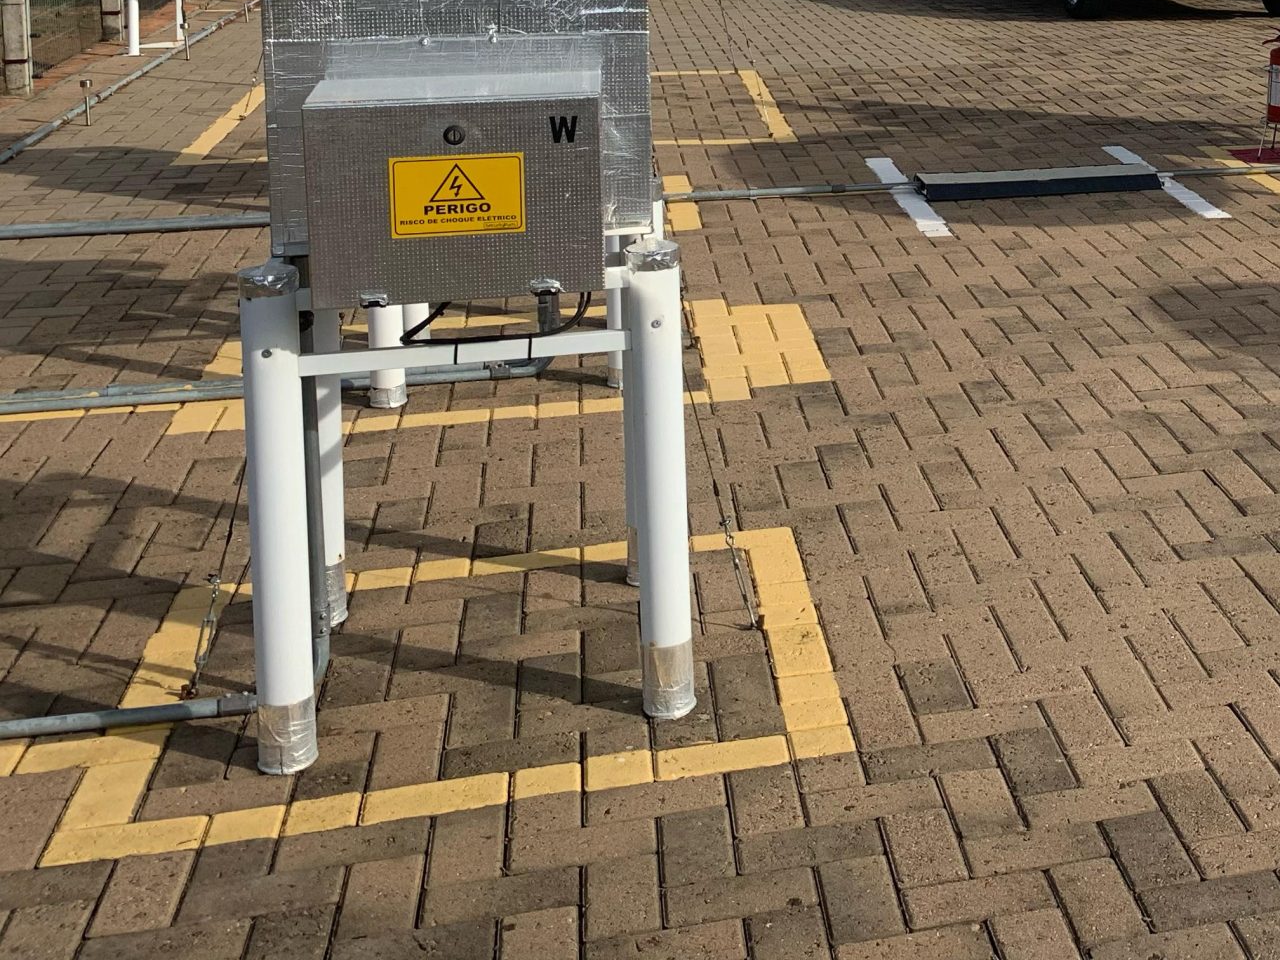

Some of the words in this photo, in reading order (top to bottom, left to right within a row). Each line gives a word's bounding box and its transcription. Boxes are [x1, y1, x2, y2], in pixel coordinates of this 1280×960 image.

[549, 115, 578, 144] W
[423, 202, 492, 216] PERIGO
[440, 216, 475, 224] CHOQUE
